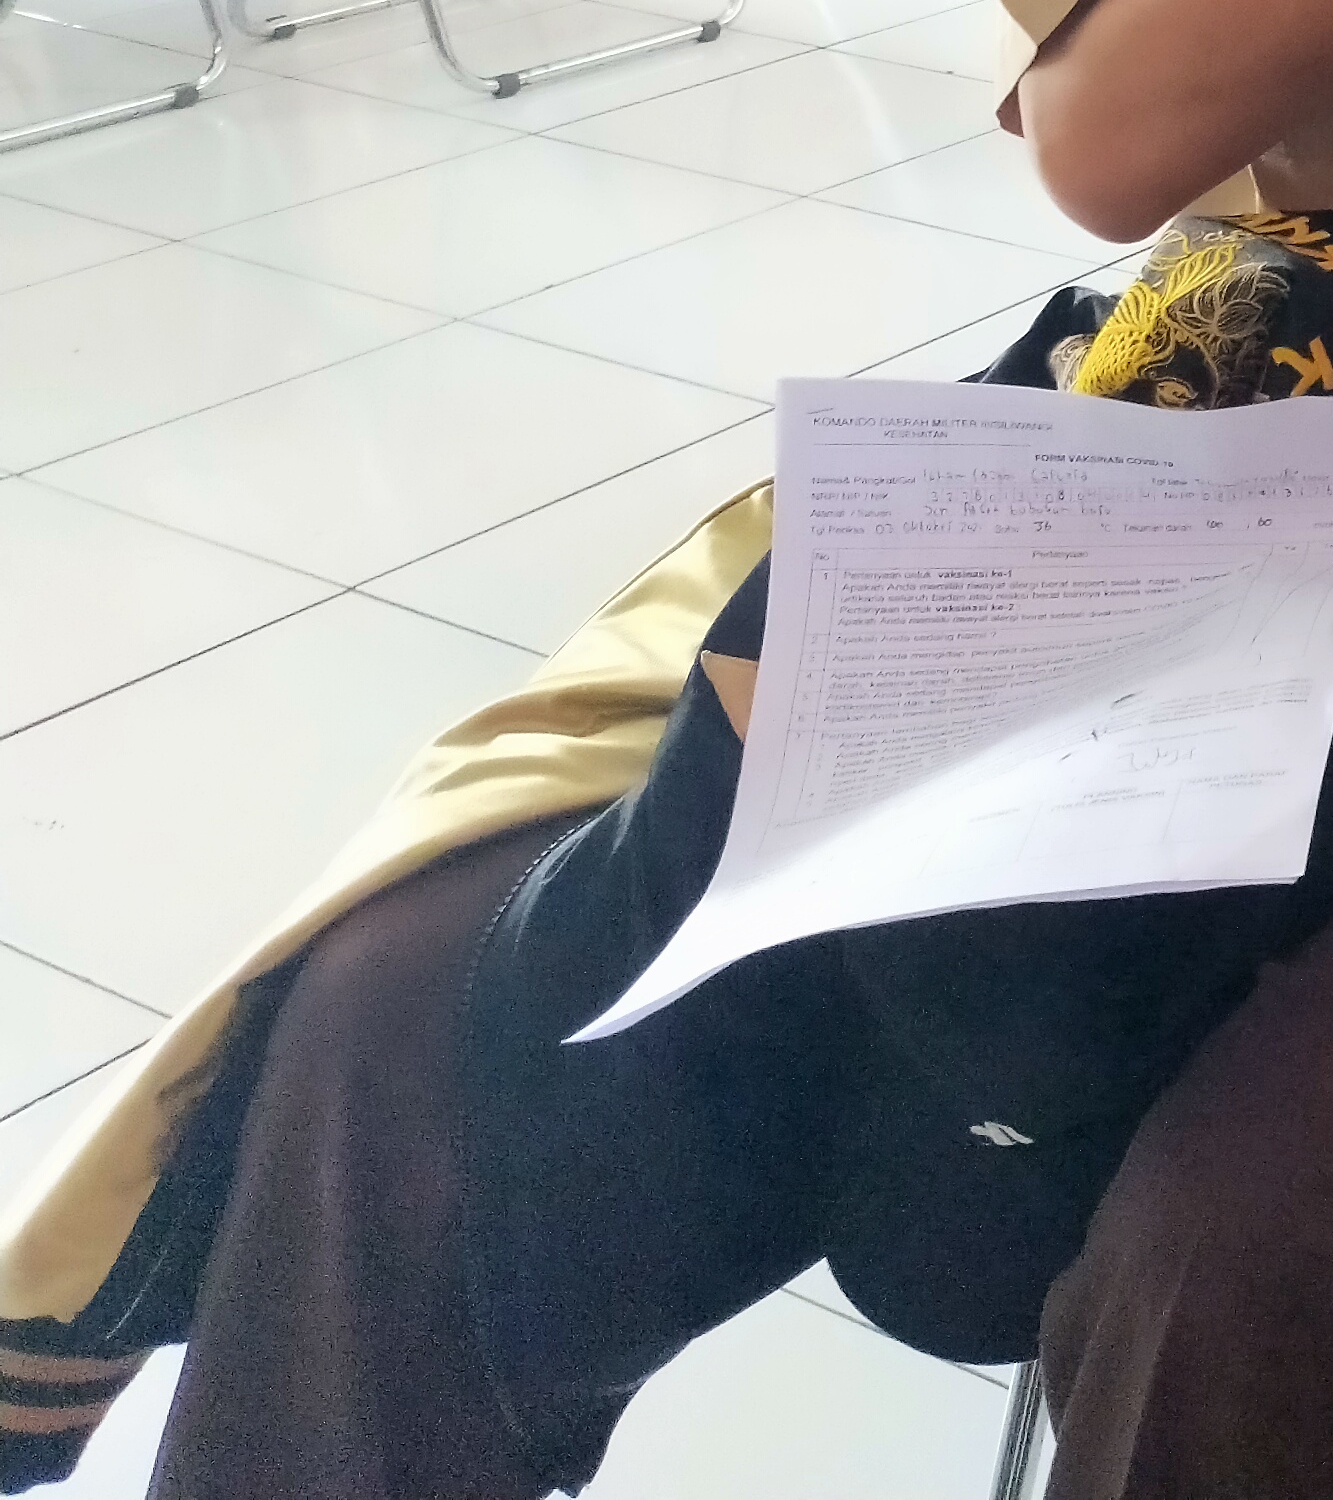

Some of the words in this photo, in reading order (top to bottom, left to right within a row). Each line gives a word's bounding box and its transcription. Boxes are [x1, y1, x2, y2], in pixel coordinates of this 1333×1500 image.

[813, 417, 876, 428] KOMANDO
[879, 417, 929, 428] DAERAH
[1034, 453, 1066, 464] FORM
[938, 570, 989, 579] vaksinasi
[886, 582, 916, 591] Anda
[935, 604, 988, 613] vaksinasi
